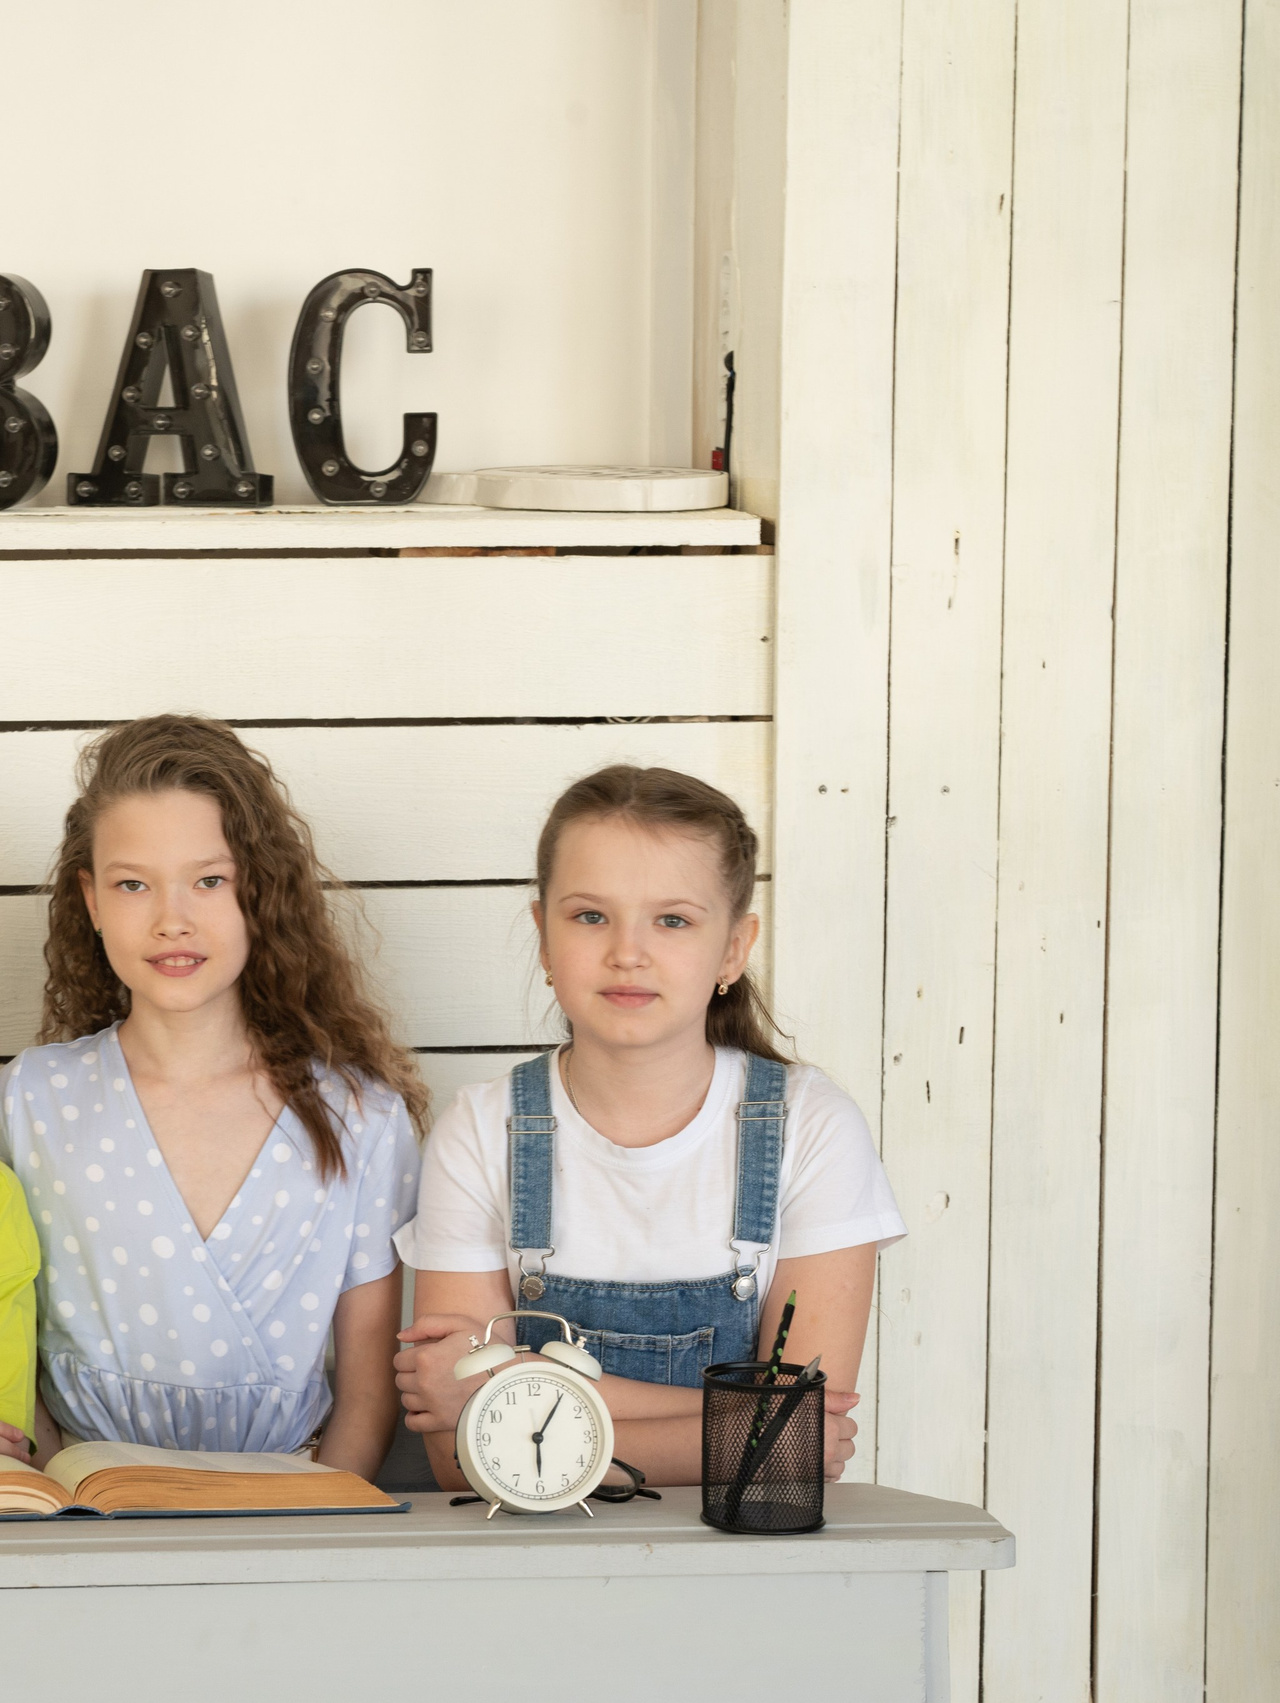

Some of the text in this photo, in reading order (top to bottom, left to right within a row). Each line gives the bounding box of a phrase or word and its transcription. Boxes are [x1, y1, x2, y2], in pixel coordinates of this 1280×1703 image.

[527, 1382, 541, 1397] 12
[506, 1391, 517, 1405] 11
[489, 1409, 502, 1424] 10
[573, 1405, 583, 1419] 2
[481, 1432, 491, 1447] 9
[583, 1430, 592, 1444] 3
[491, 1457, 501, 1471] 8
[575, 1454, 585, 1468] 4
[512, 1473, 520, 1487] 7
[535, 1480, 545, 1494] 6
[560, 1473, 570, 1487] 5
